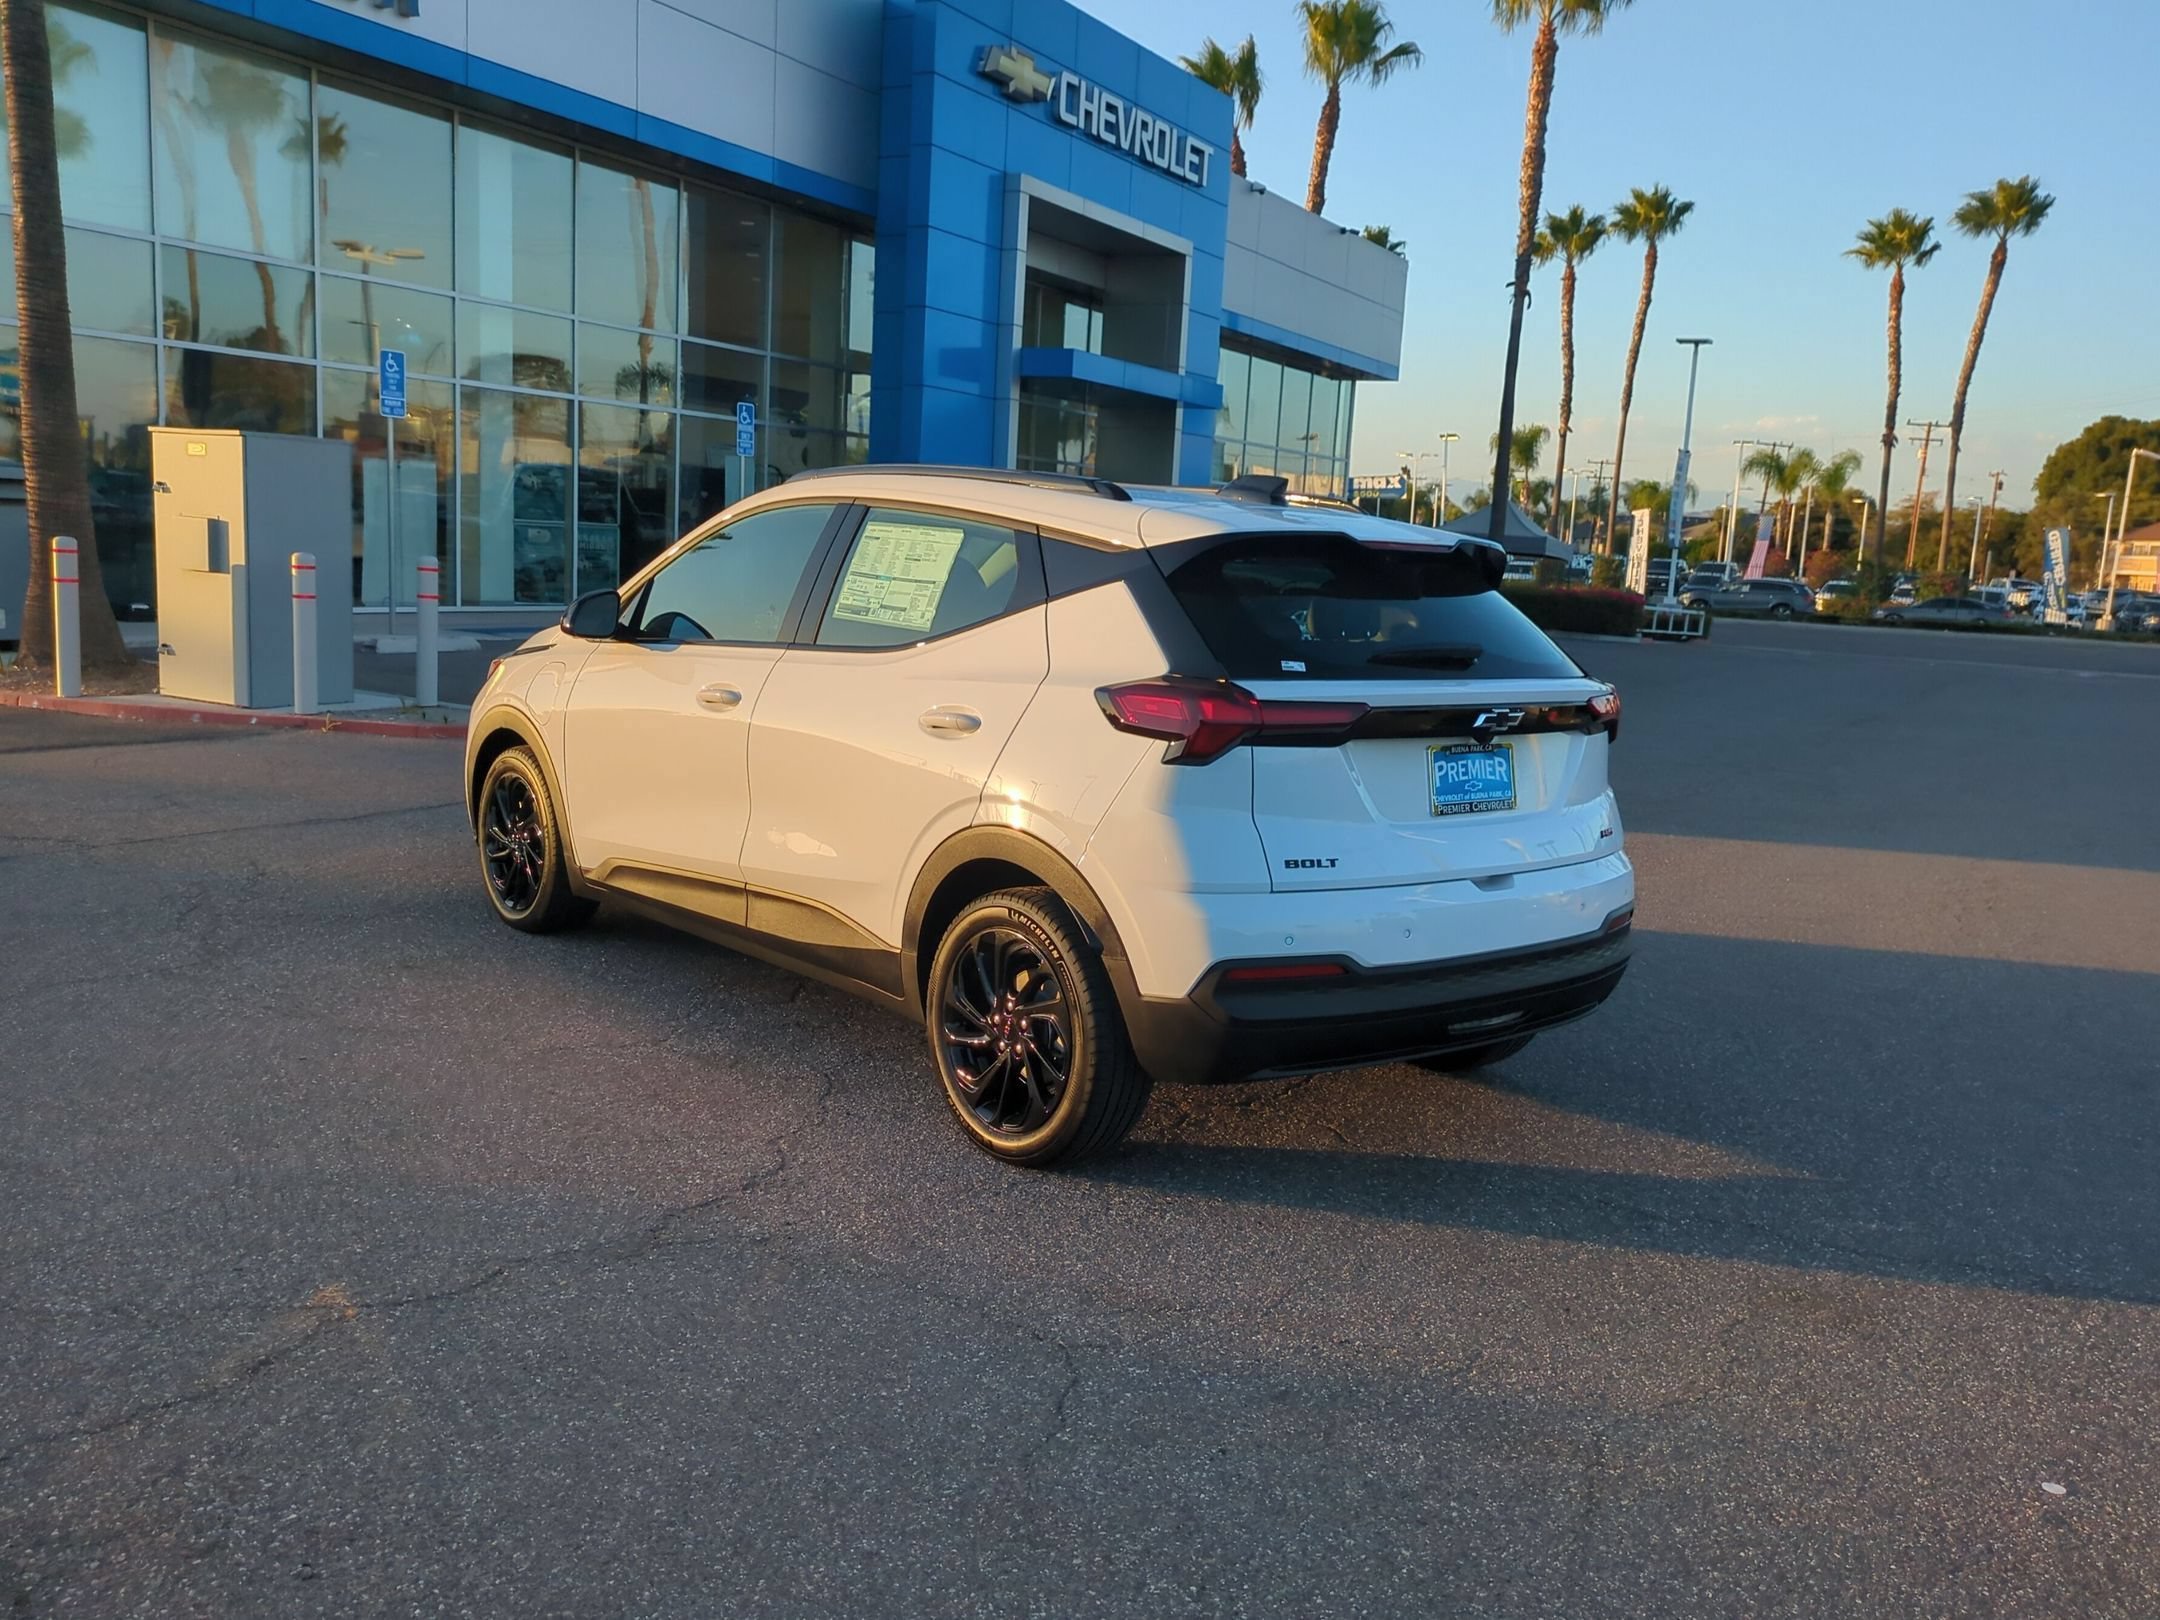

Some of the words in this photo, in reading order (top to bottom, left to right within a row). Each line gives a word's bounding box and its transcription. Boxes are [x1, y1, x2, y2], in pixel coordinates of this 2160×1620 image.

[1058, 71, 1214, 188] CHEVROLET
[1451, 746, 1469, 754] BUENA
[1485, 744, 1493, 752] CA
[1434, 756, 1509, 788] PREMIER
[1433, 793, 1464, 803] CHEVROLET
[1471, 791, 1489, 800] BUENA
[1504, 789, 1512, 798] CA
[1438, 803, 1471, 815] PREMIER
[1472, 799, 1513, 812] CHEVROLET
[1284, 858, 1339, 869] BOLT
[1019, 914, 1060, 959] MICHELIN
